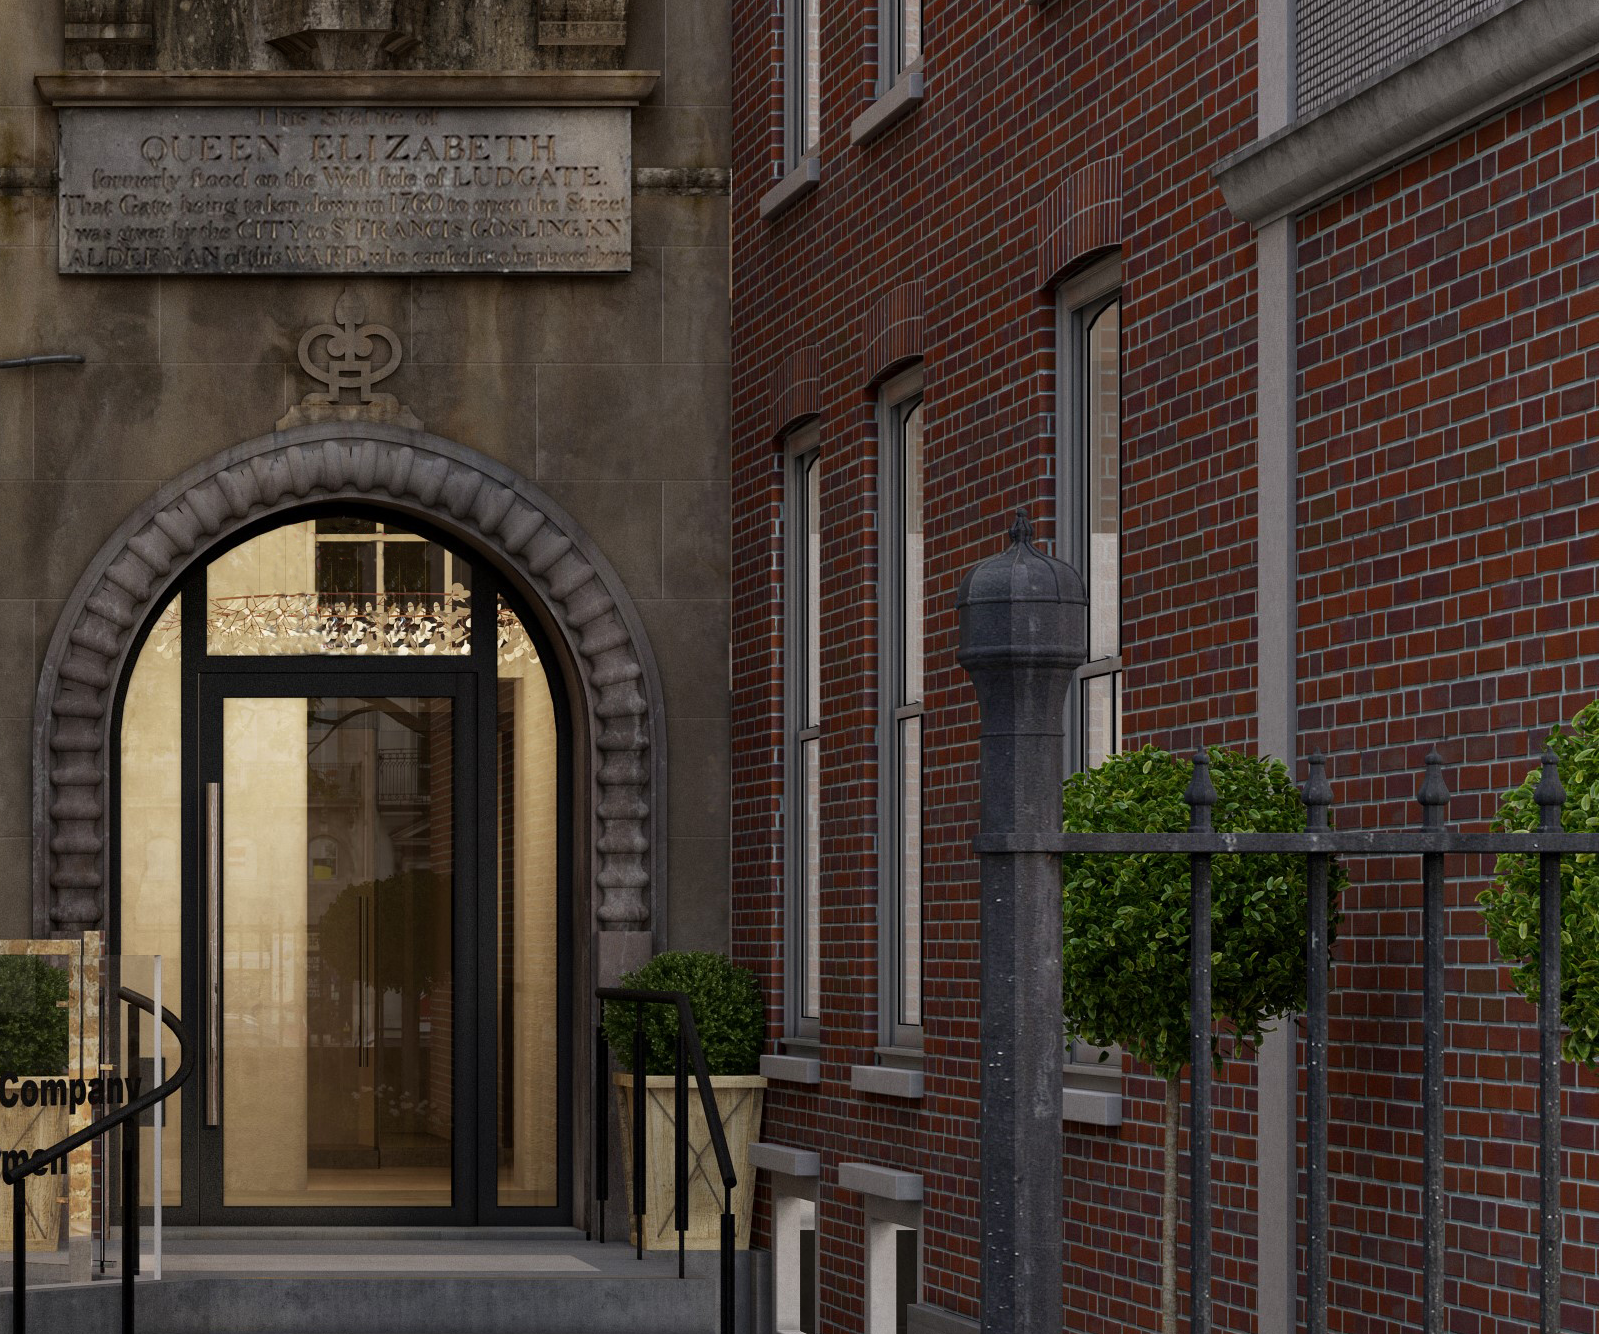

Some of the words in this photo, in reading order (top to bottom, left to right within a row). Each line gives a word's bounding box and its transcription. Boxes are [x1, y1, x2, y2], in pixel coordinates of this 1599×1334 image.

[140, 134, 283, 168] QUEEN
[309, 133, 557, 162] ELIZABETH
[389, 192, 444, 215] 1760
[237, 218, 305, 241] CITY
[355, 219, 463, 240] FRANCIS
[68, 245, 221, 269] ALDERMAN
